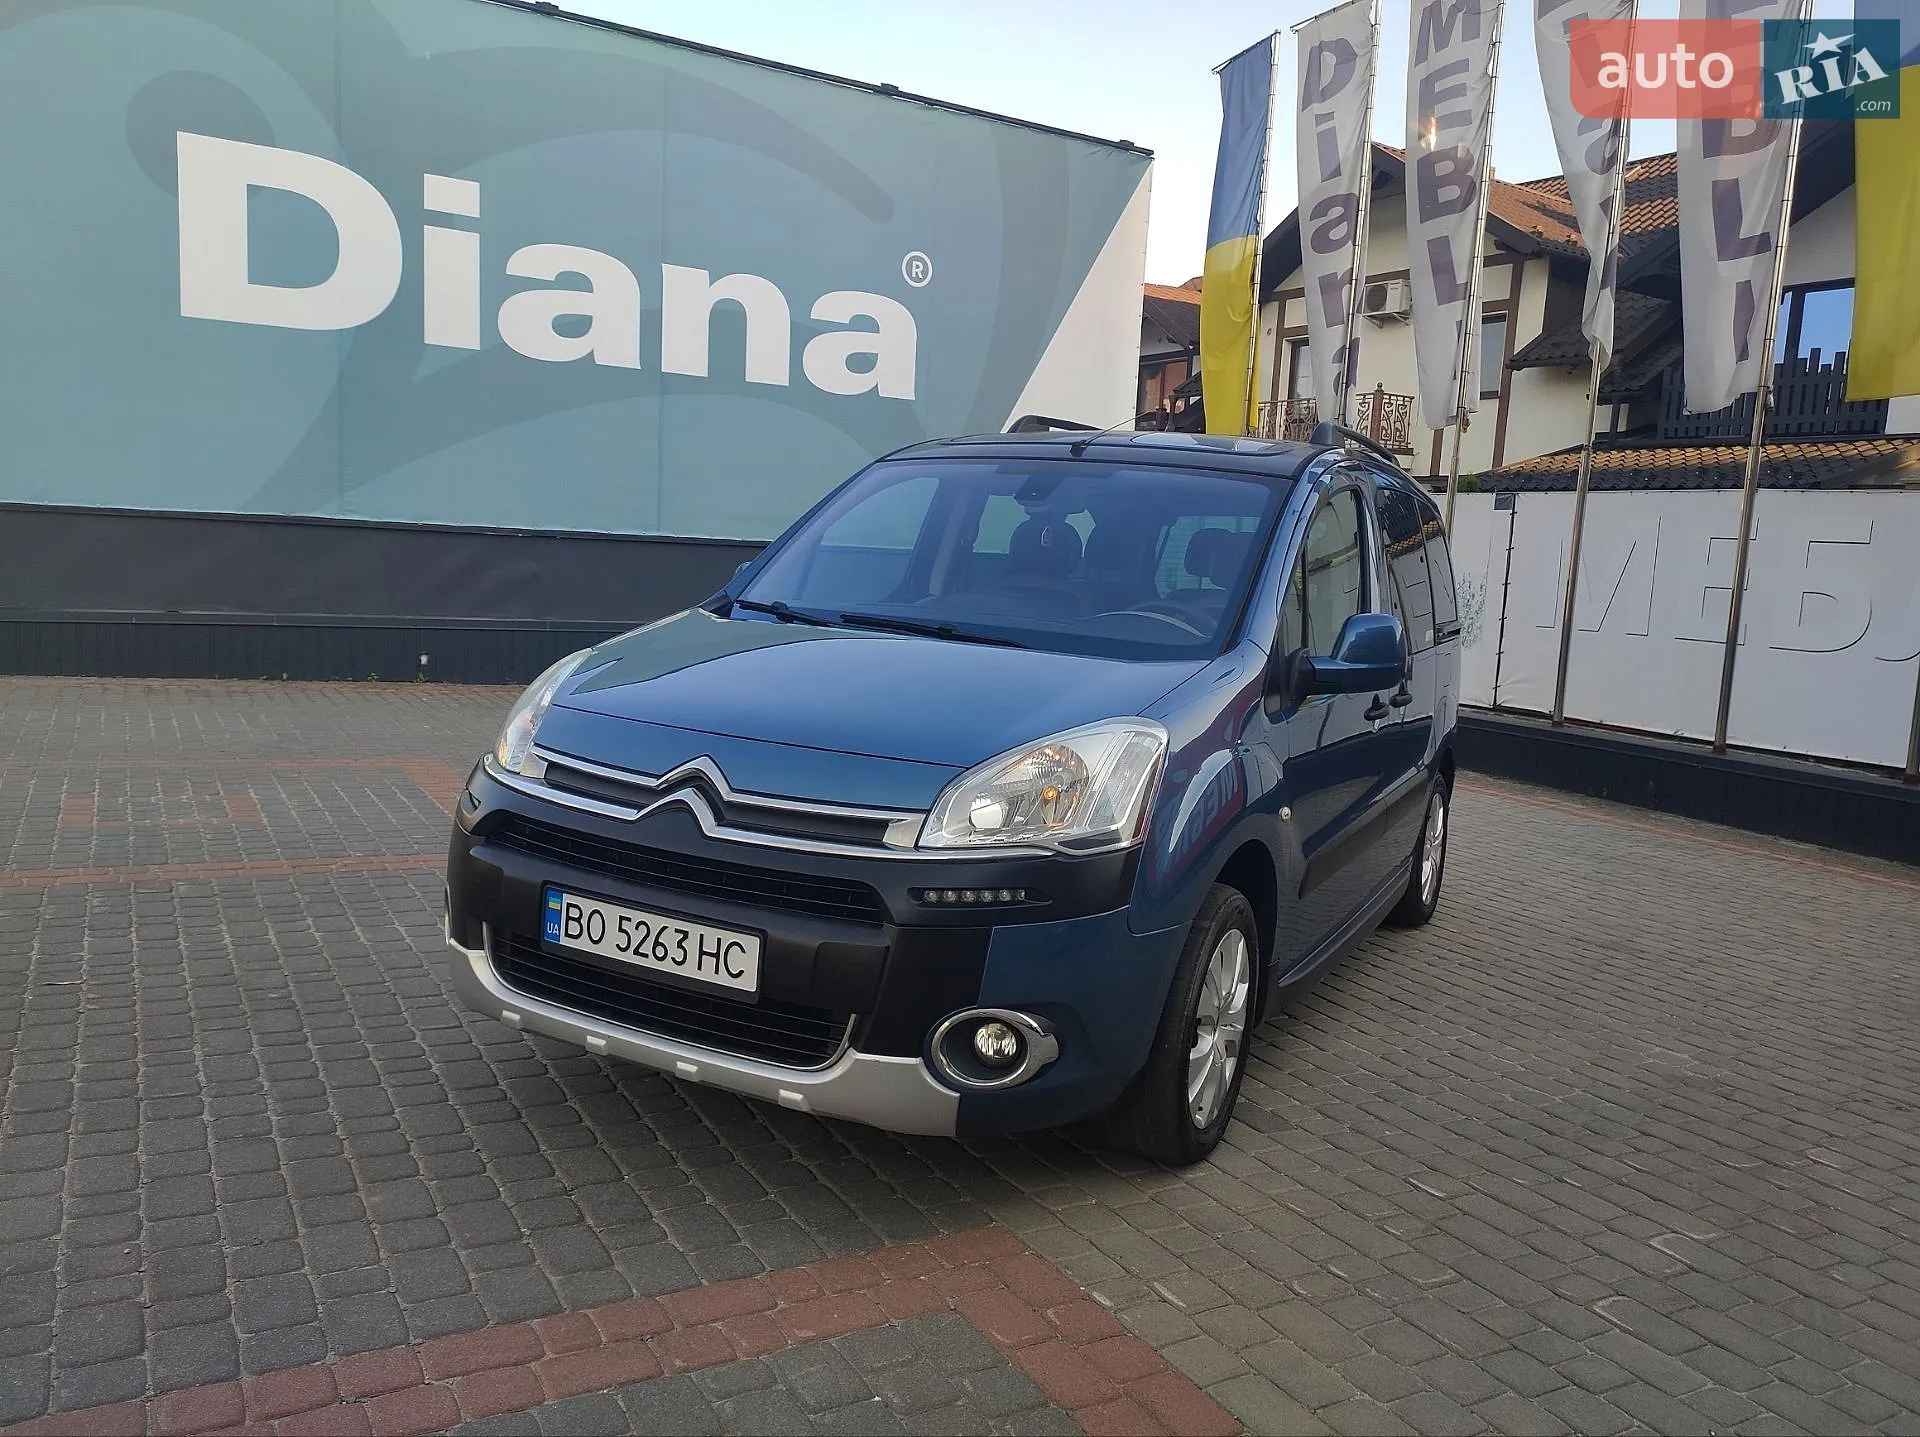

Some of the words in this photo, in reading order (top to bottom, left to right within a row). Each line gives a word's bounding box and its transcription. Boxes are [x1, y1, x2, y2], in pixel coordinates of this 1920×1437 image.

[177, 131, 918, 400] Diana
[547, 922, 560, 936] UA
[564, 902, 606, 945] BO
[615, 915, 690, 966] 5263
[696, 933, 747, 979] HC
